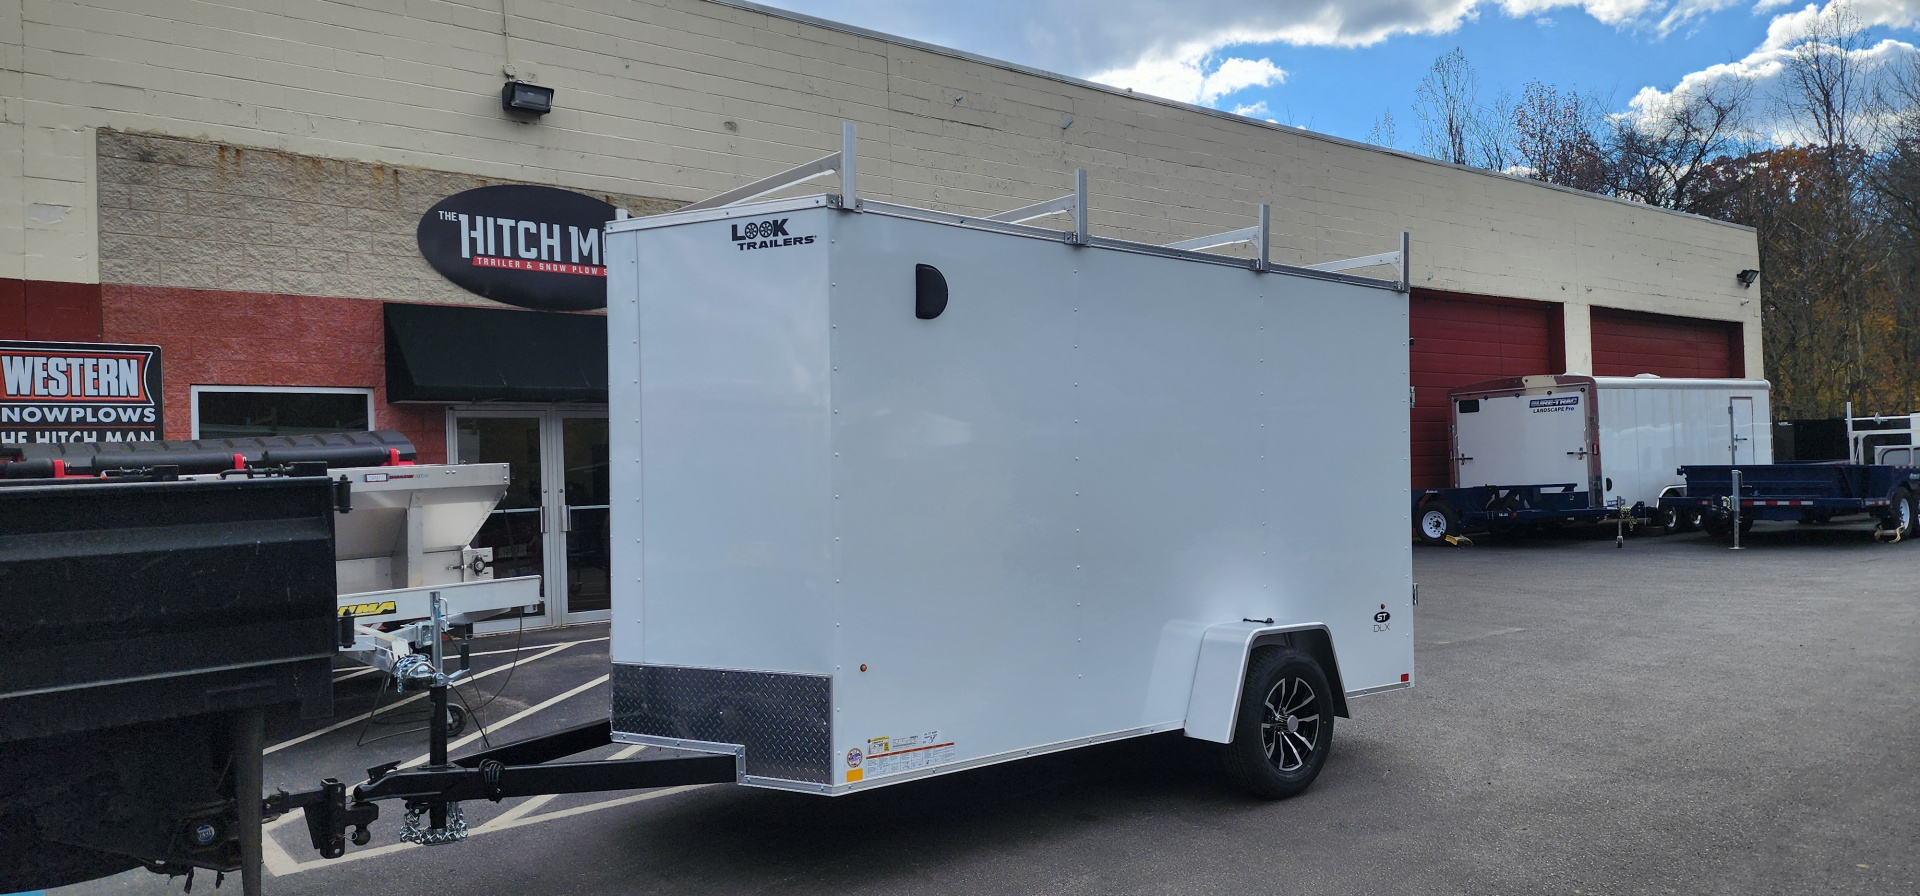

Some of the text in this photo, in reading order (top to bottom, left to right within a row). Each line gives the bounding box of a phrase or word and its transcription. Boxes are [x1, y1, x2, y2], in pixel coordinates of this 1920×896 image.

[438, 210, 457, 222] THE
[458, 213, 561, 262] HITCH
[731, 218, 789, 241] LOOK
[737, 235, 815, 251] TRAILERS
[477, 257, 520, 268] TRAILER
[526, 261, 533, 269] &
[539, 262, 566, 272] SNOW
[572, 265, 598, 275] PLOW
[1, 355, 139, 397] WESTERN
[35, 431, 97, 443] HITCH
[1373, 623, 1390, 633] DLX
